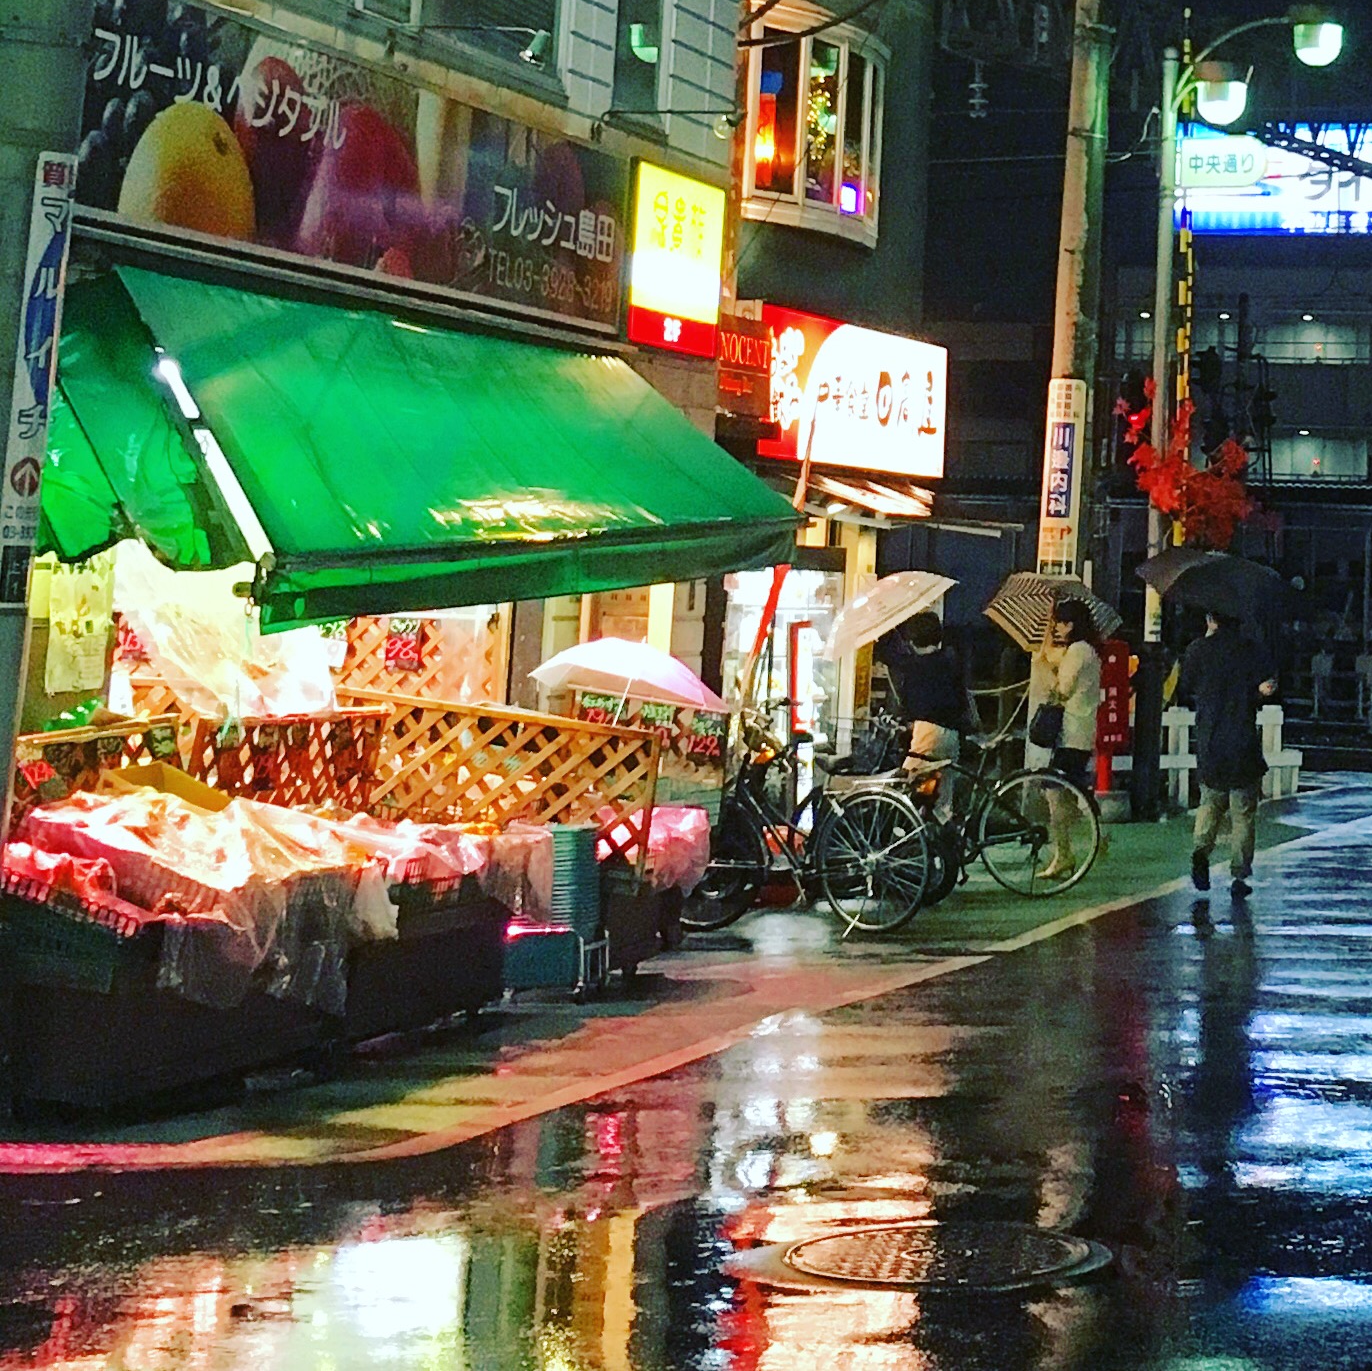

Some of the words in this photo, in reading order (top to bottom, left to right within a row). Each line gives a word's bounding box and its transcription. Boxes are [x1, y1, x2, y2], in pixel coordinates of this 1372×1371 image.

[1188, 154, 1255, 174] 中央通り
[493, 185, 616, 263] フレッシュ島田
